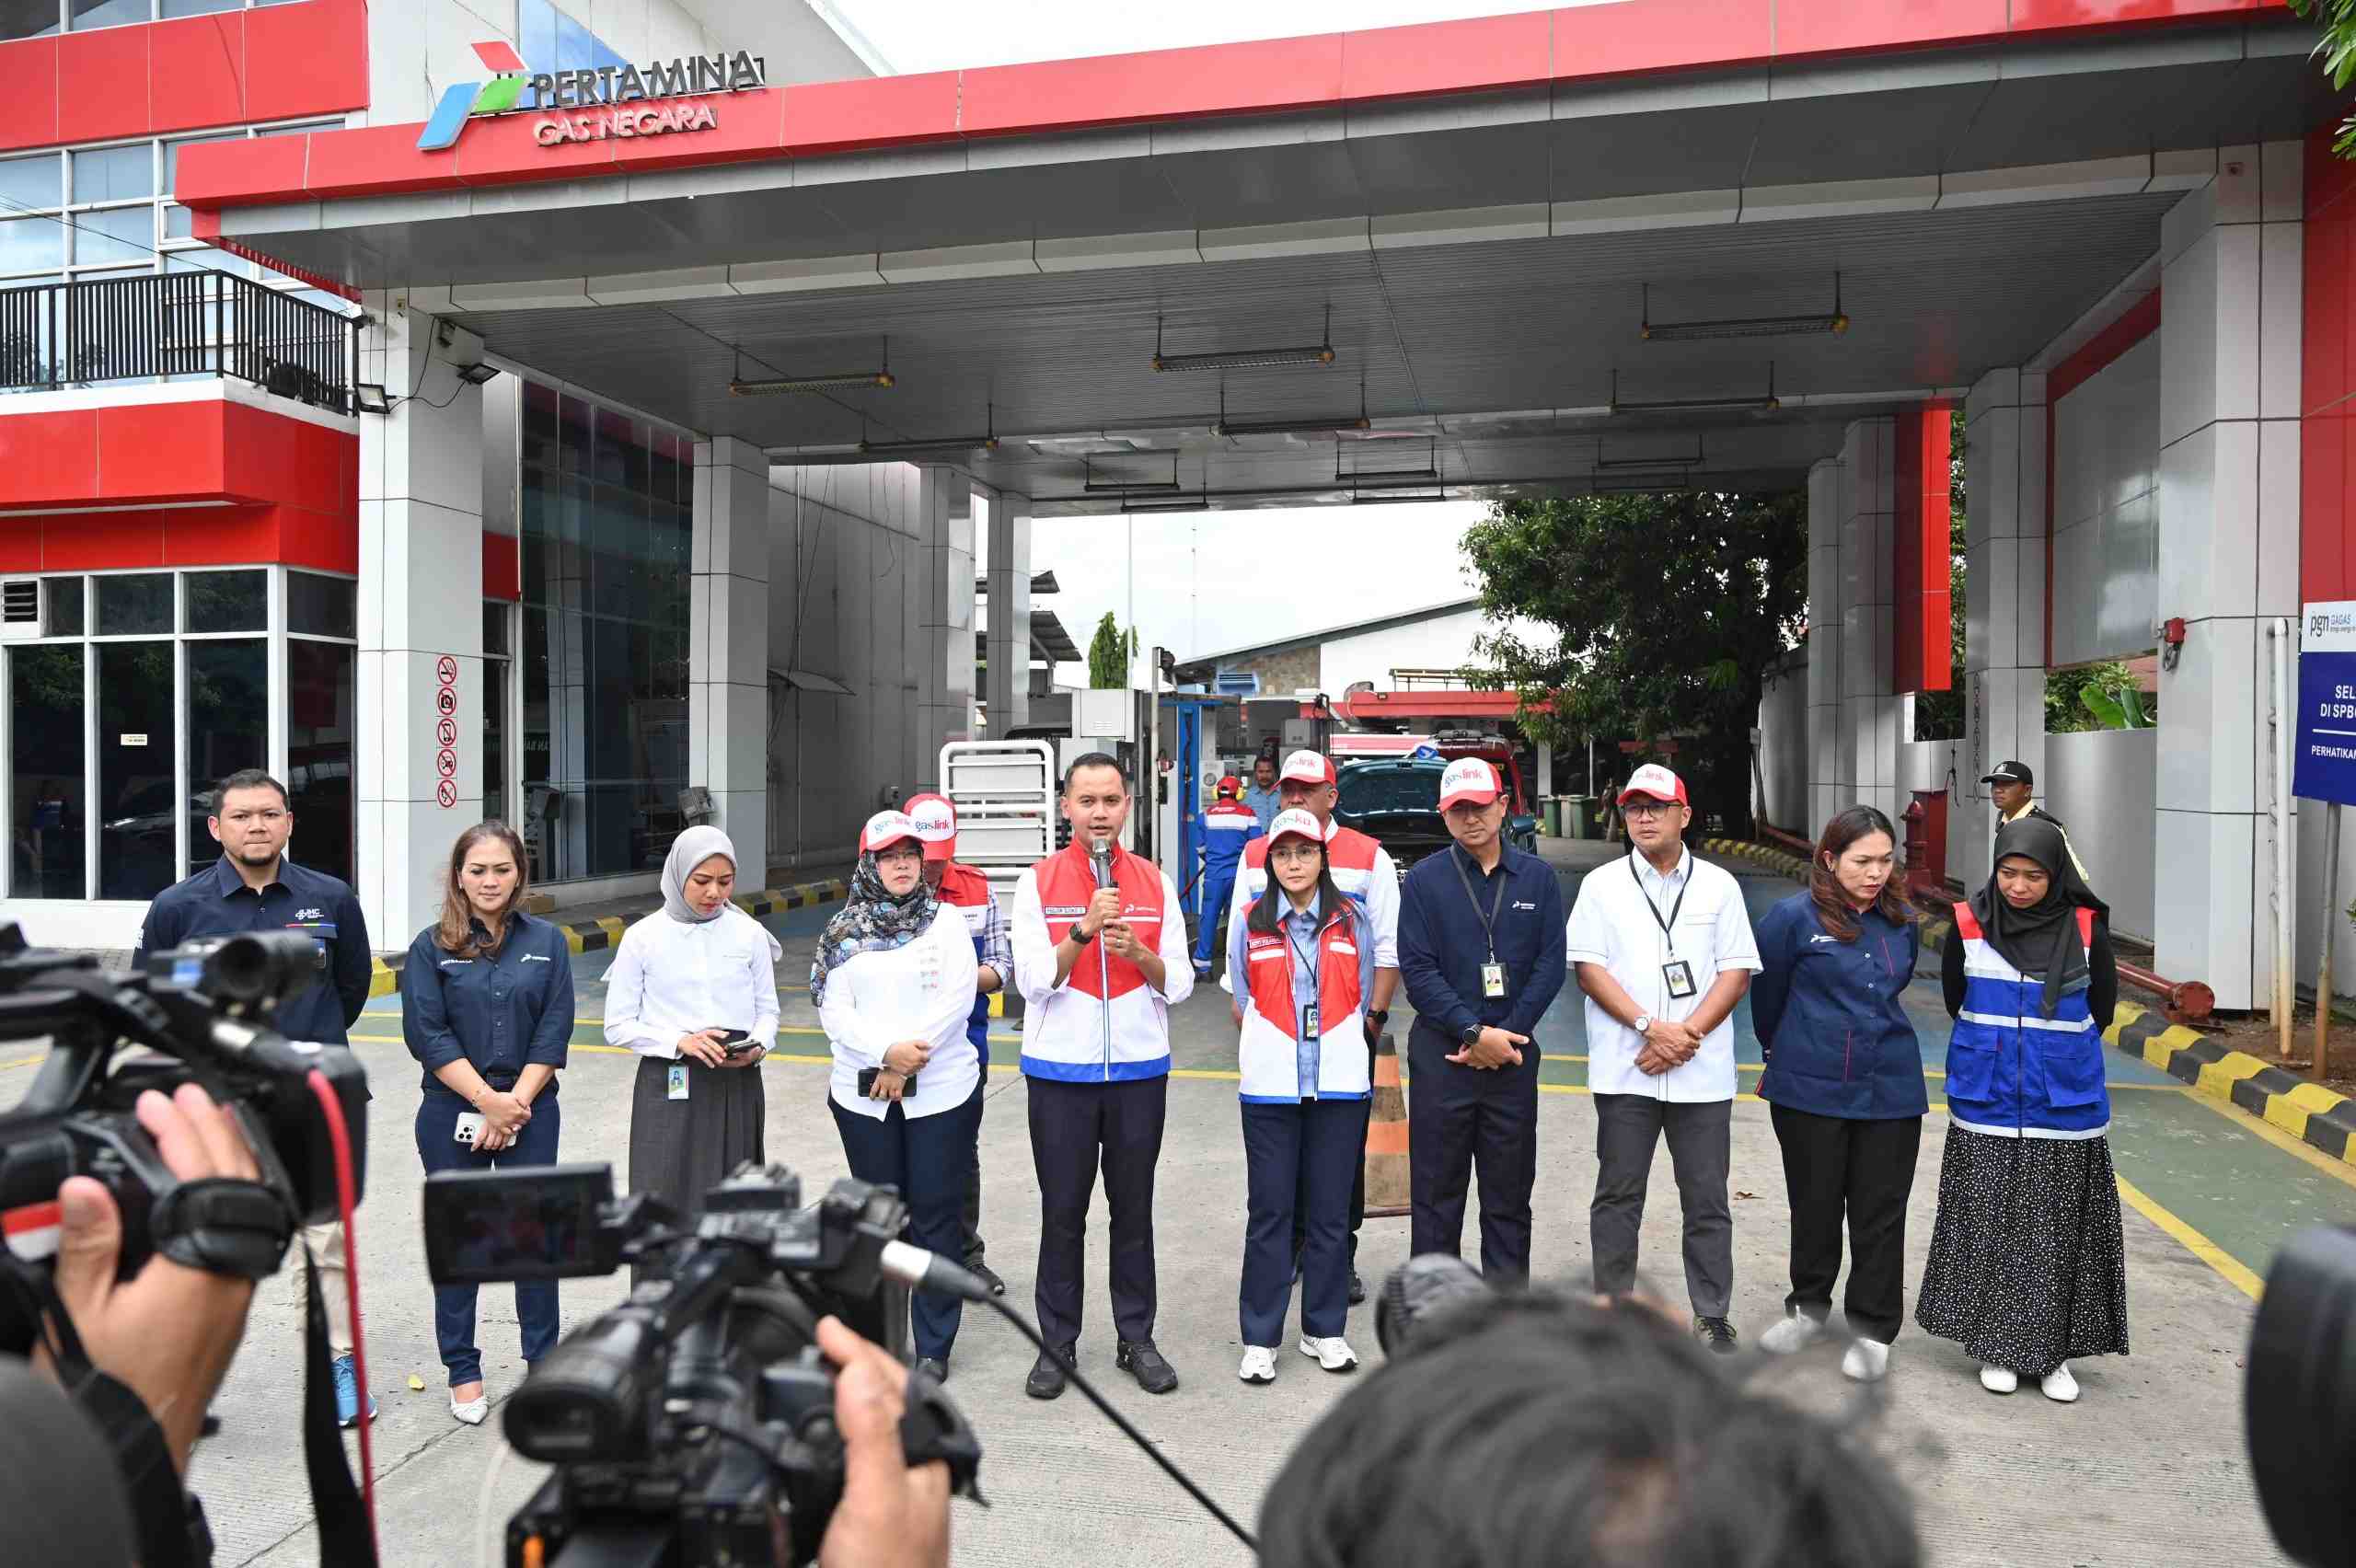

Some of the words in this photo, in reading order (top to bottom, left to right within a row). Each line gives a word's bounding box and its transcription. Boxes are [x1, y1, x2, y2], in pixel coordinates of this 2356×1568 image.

[533, 50, 763, 108] PERTAMINA
[534, 115, 591, 145] GAS
[599, 104, 716, 140] NEGARA
[2310, 615, 2329, 638] pgn
[2335, 685, 2356, 699] SEL
[2320, 703, 2331, 718] DI
[2333, 704, 2356, 719] SPB
[1445, 767, 1484, 789] gaslink
[915, 818, 950, 833] gaslink
